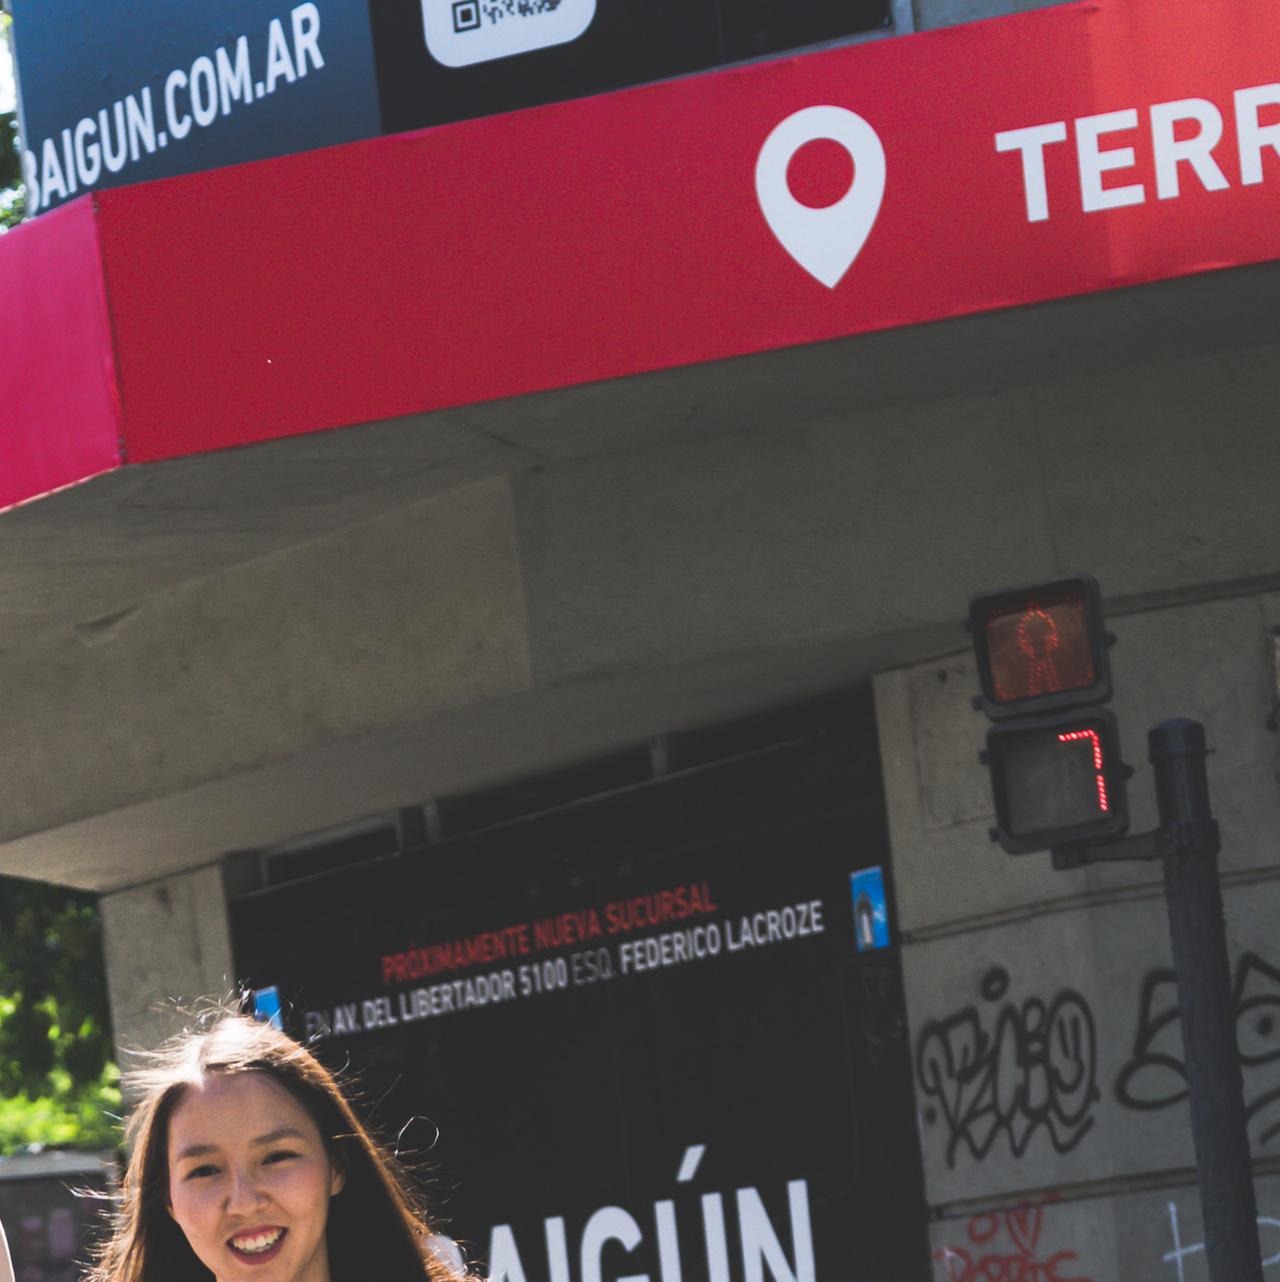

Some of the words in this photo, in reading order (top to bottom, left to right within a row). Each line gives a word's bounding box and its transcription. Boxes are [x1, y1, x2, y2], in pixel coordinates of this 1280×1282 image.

[1058, 728, 1108, 811] 7
[333, 1002, 362, 1037] AV.
[362, 996, 398, 1030] DEL
[399, 969, 517, 1022] LIBERTADOR
[518, 957, 569, 996] 5100
[619, 923, 721, 975] FEDERICO
[725, 899, 825, 951] LACROZE
[381, 923, 530, 985] PRÓXIMAMENTE
[533, 907, 603, 951] NUEVA
[605, 882, 718, 935] SUCURSAL
